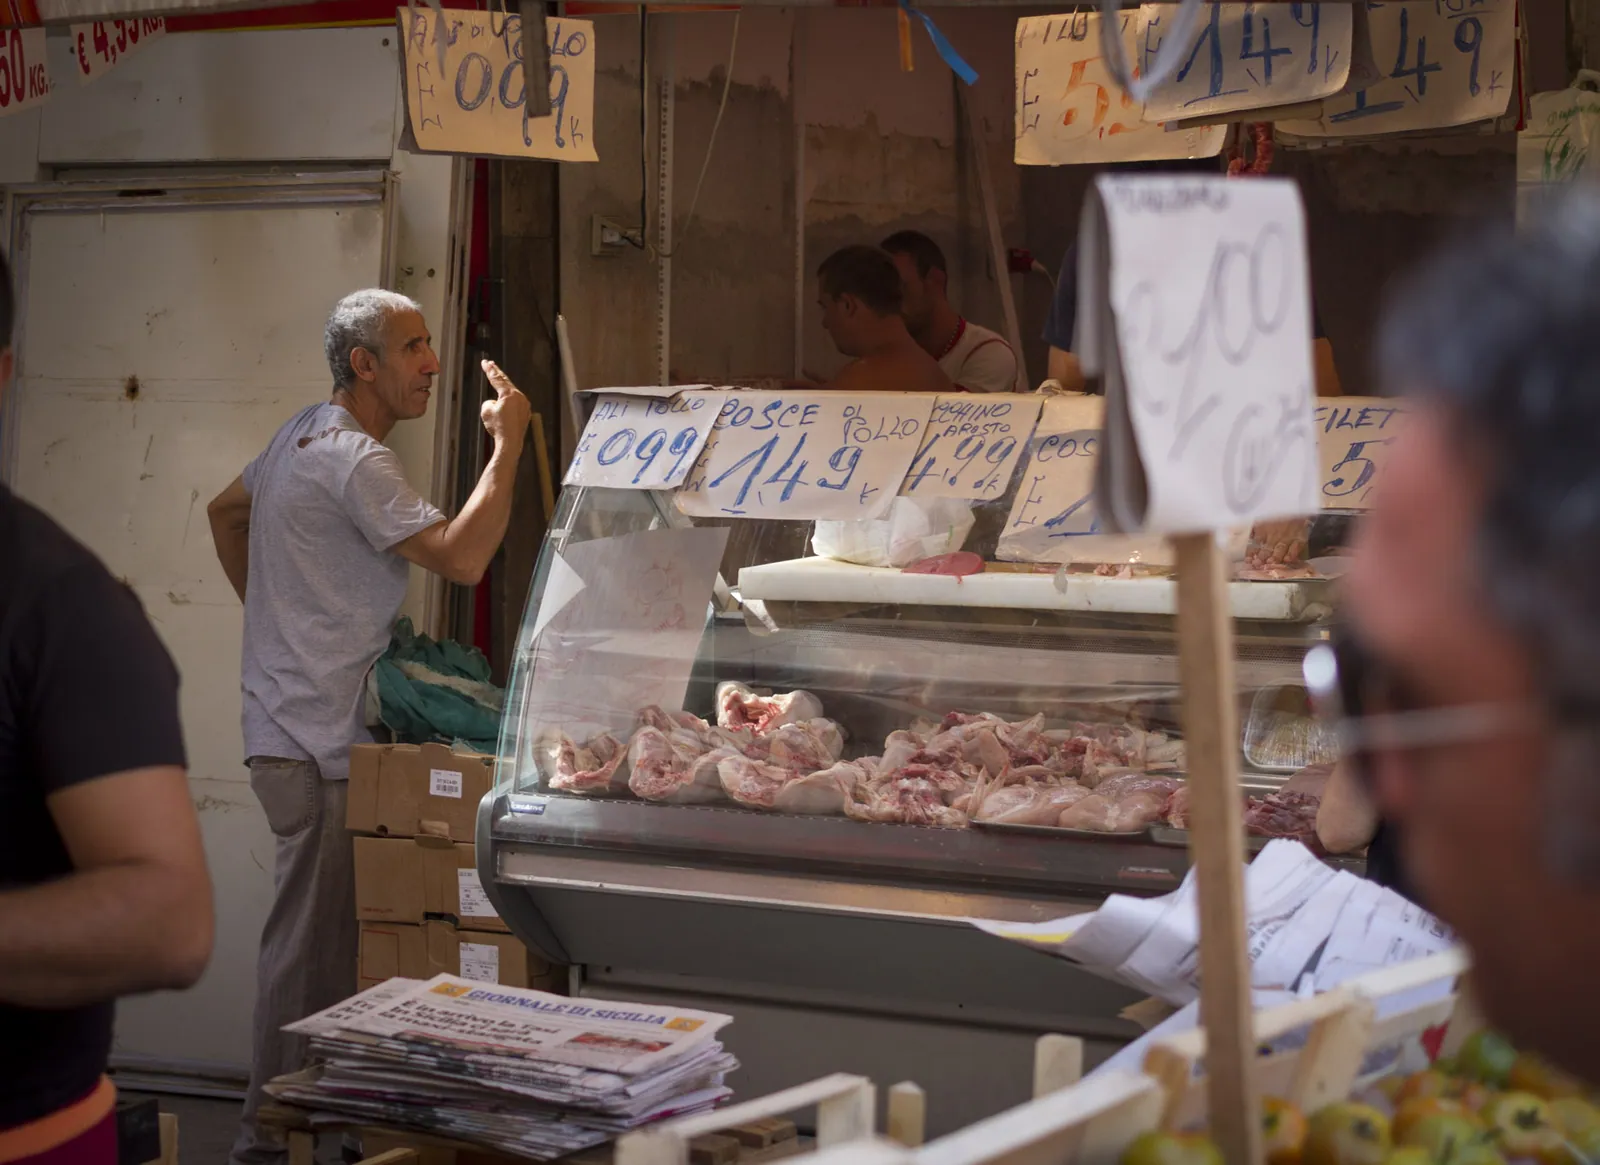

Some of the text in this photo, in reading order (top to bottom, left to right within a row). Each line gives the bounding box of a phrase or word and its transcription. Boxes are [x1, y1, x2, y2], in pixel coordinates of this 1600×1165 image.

[502, 15, 586, 59] POLO
[713, 398, 821, 430] COSCE
[844, 416, 919, 443] POLLO
[1037, 435, 1097, 462] COS
[466, 989, 667, 1025] GIORNALE DI SICILIA
